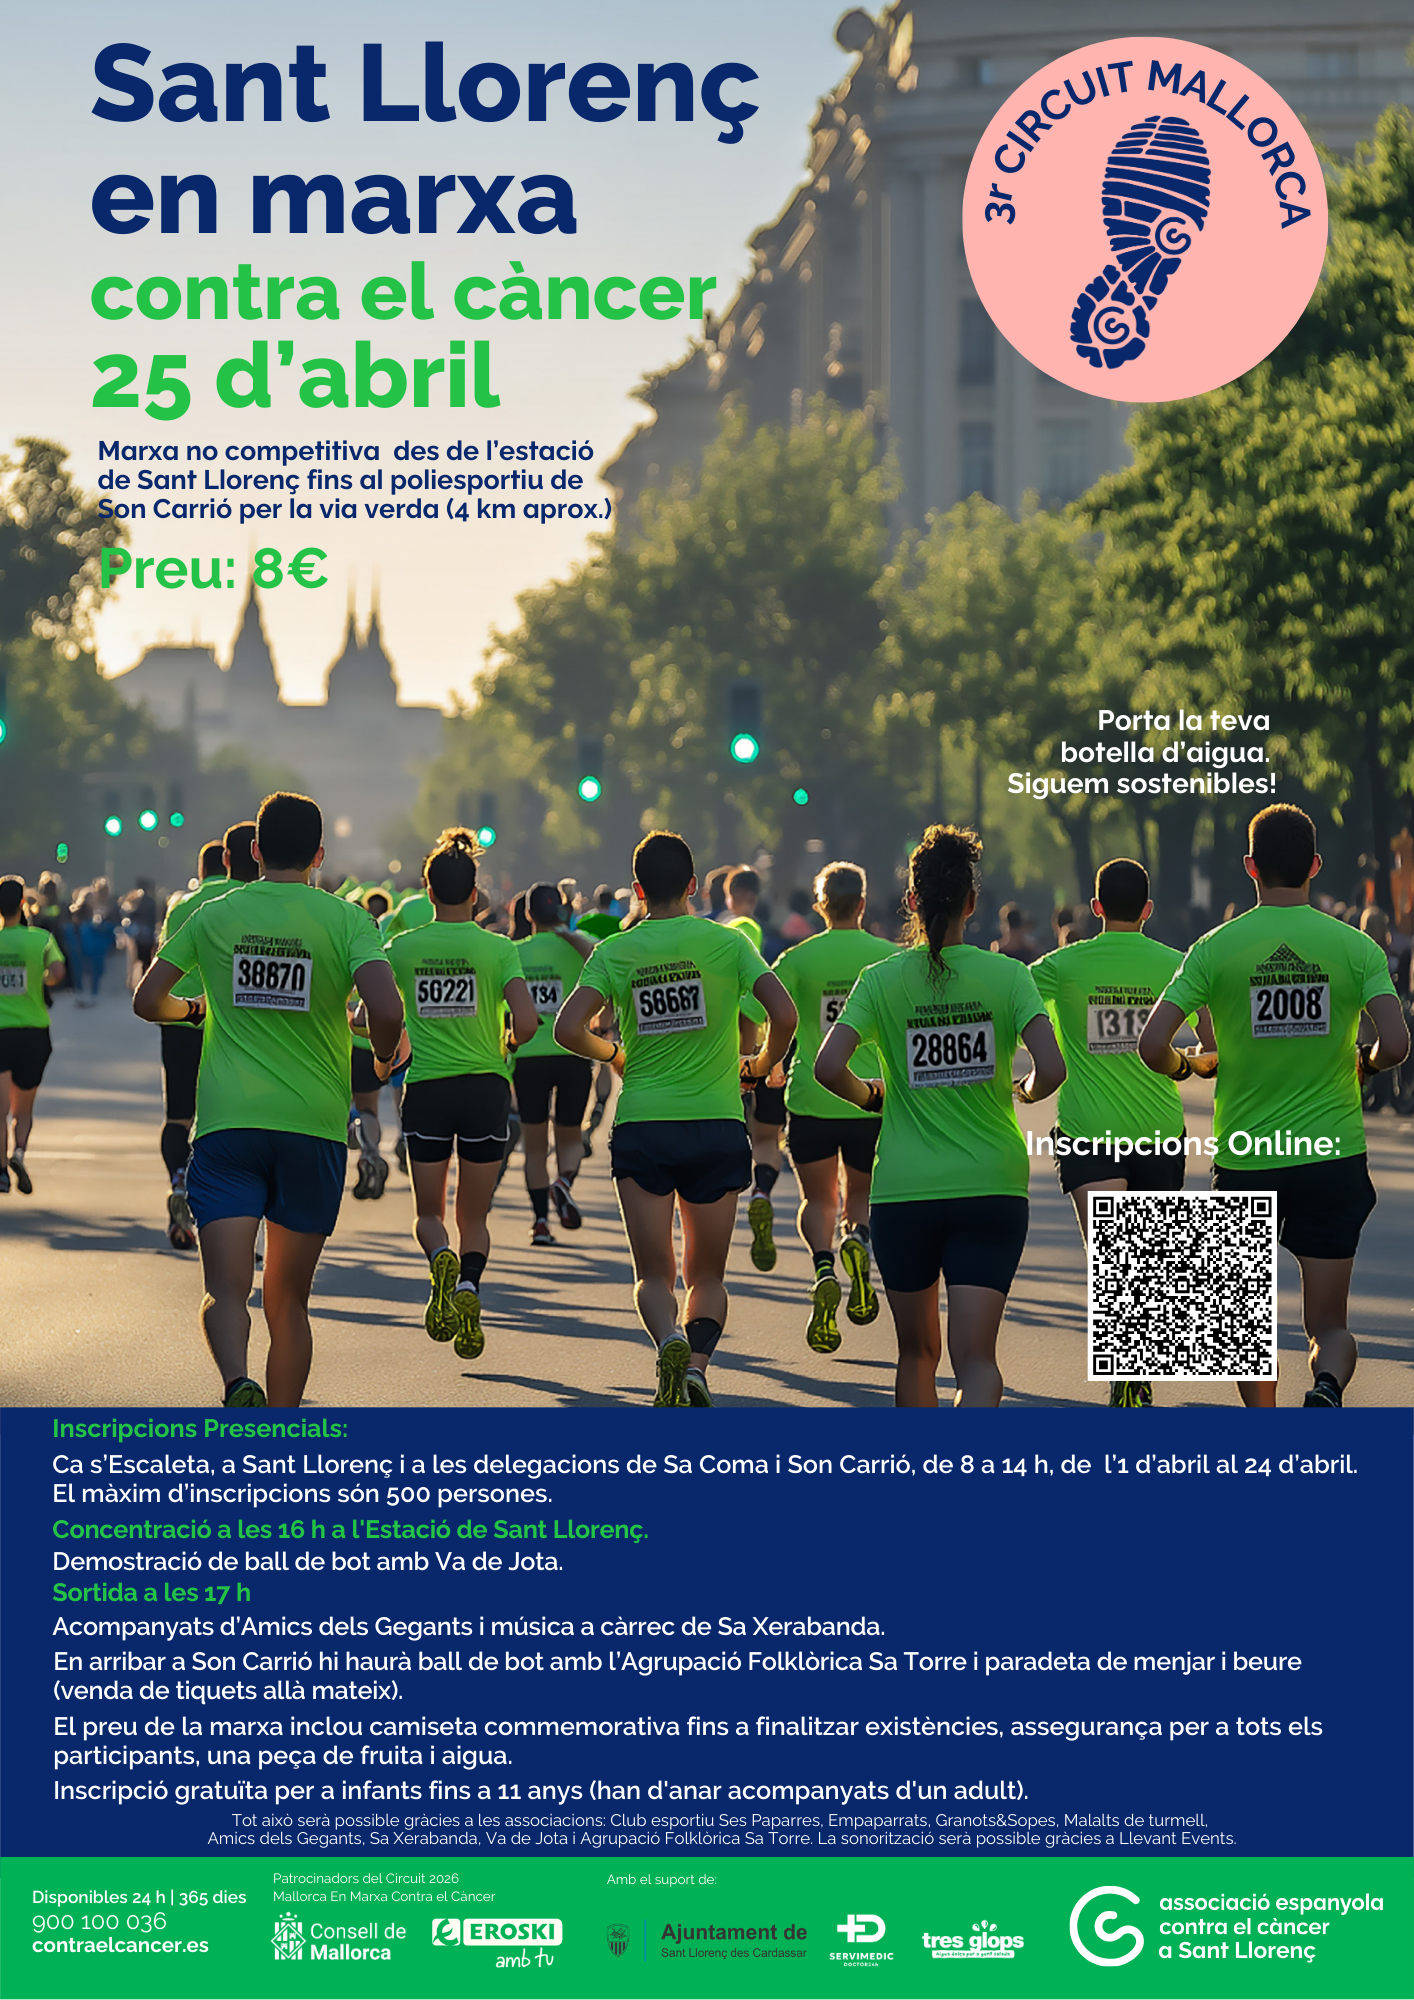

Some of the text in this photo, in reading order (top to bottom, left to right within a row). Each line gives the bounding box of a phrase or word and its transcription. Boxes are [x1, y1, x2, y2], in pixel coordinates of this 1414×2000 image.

[91, 41, 759, 145] Sant Llorenç
[985, 59, 1312, 230] 3r CIRCUIT MALLORCA
[91, 174, 577, 235] en marxa
[91, 260, 717, 321] contra el càncer
[92, 340, 501, 421] 25 d’abril
[99, 440, 594, 466] Marxa no competitiva des de l’estació
[98, 468, 583, 495] de Sant Llorenç fins al poliesportiu de
[97, 497, 612, 524] Son Carrió per la via verda (4 km aprox.)
[101, 547, 328, 589] Preu: 8€
[1098, 709, 1270, 731] Porta la teva
[1061, 741, 1270, 769] botella d’aigua.
[1007, 772, 1276, 800] Siguem sostenibles!
[1257, 988, 1322, 1021] 2008
[912, 1031, 987, 1068] 28864
[1026, 1129, 1340, 1167] Inscripcions Online:
[53, 1418, 348, 1443] Inscripcions Presencials:
[53, 1482, 553, 1509] El màxim d’inscripcions són 500 persones.
[53, 1550, 563, 1571] Demostració de ball de bot amb Va de Jota.
[52, 1582, 251, 1605] Sortida a les 17 h
[53, 1679, 403, 1706] (venda de tiquets allà mateix).
[54, 1744, 513, 1771] participants, una peça de fruita i aigua.
[231, 1813, 1208, 1830] Tot això serà possible gràcies a les associacions: Club esportiu Ses Paparres, Empaparrats, Granots&Sopes, Malalts de turmell,
[273, 1872, 460, 1884] Patrocinadors del Circuit 2026
[606, 1873, 717, 1888] Amb el suport de:
[32, 1889, 247, 1908] Disponibles 24 h 365 dies
[273, 1890, 496, 1902] Mallorca En Marxa Contra el Càncer
[1159, 1892, 1384, 1916] associació espanyola
[32, 1911, 167, 1934] 900 100 036
[310, 1922, 407, 1940] Consell de
[469, 1922, 555, 1941] EROSKI
[660, 1923, 808, 1945] Ajuntament de
[1159, 1917, 1330, 1935] contra el càncer
[32, 1936, 209, 1953] contraelcancer.es
[310, 1943, 392, 1961] Mallorca
[921, 1929, 1025, 1951] tres glops
[1158, 1940, 1316, 1964] a Sant Llorenç
[495, 1947, 554, 1968] amb tu
[661, 1947, 808, 1960] Sant Llorenç des Cardassar
[829, 1952, 894, 1961] SERVIMEDIC
